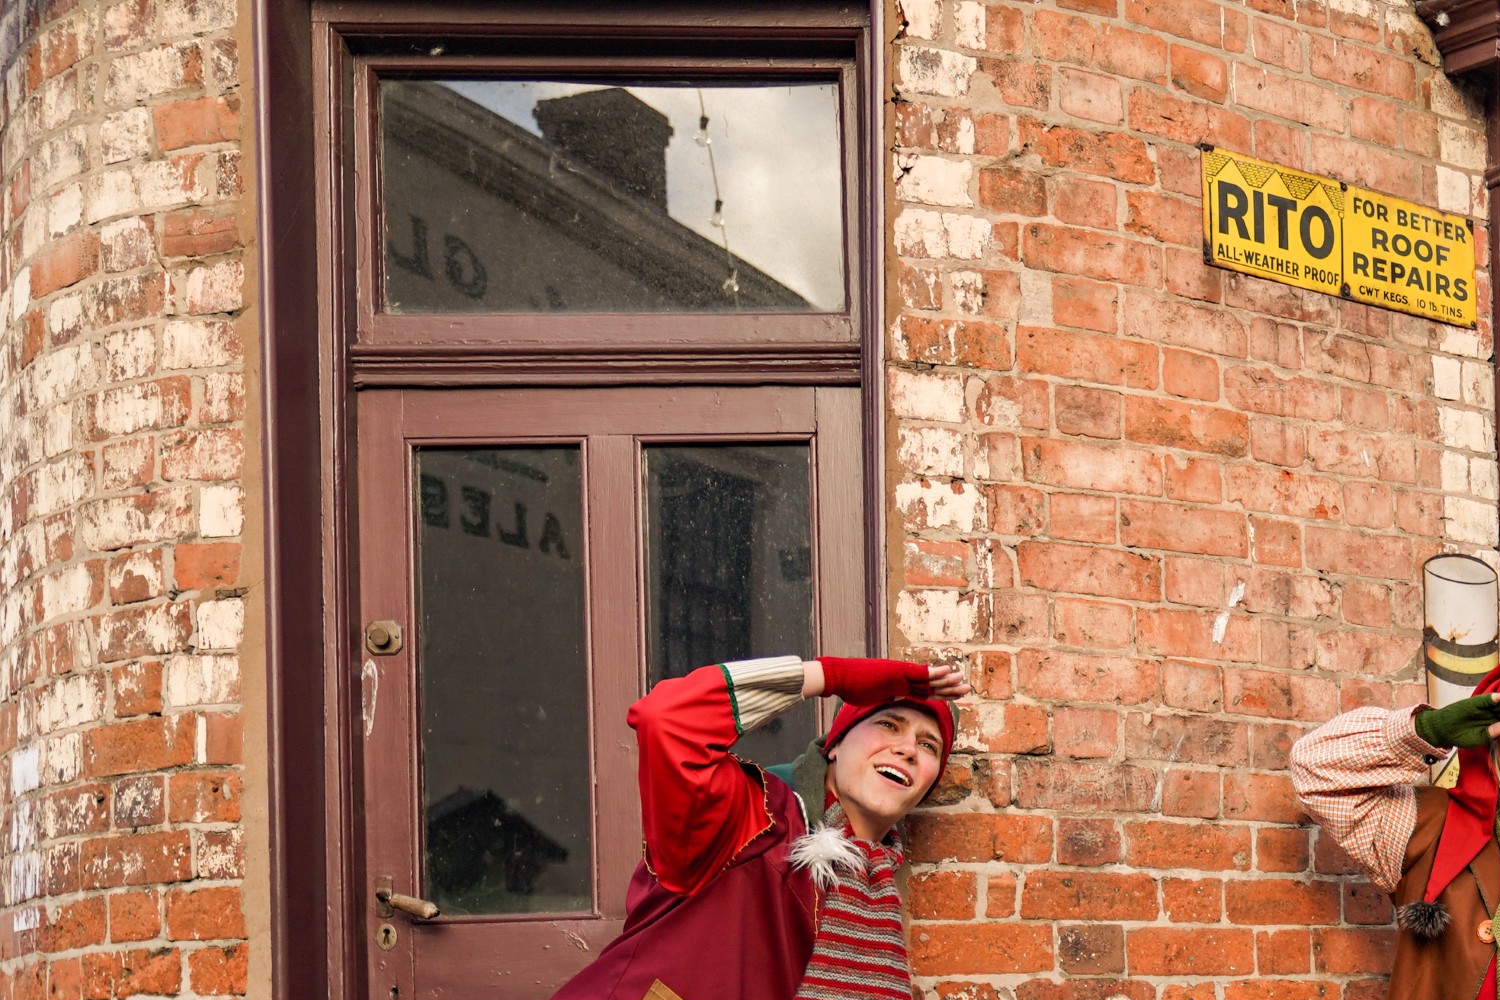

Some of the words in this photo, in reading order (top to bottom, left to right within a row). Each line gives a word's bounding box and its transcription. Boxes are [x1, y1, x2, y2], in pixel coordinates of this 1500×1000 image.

[1217, 180, 1335, 260] RITO
[1353, 197, 1389, 222] FOR
[1396, 208, 1466, 243] BETTER
[1217, 243, 1299, 277] ALL-WEATHER
[1304, 265, 1340, 286] PROOF
[1371, 227, 1450, 266] ROOF
[1352, 252, 1468, 302] REPAIRS
[1358, 285, 1380, 298] CWT
[1416, 298, 1426, 309] 10
